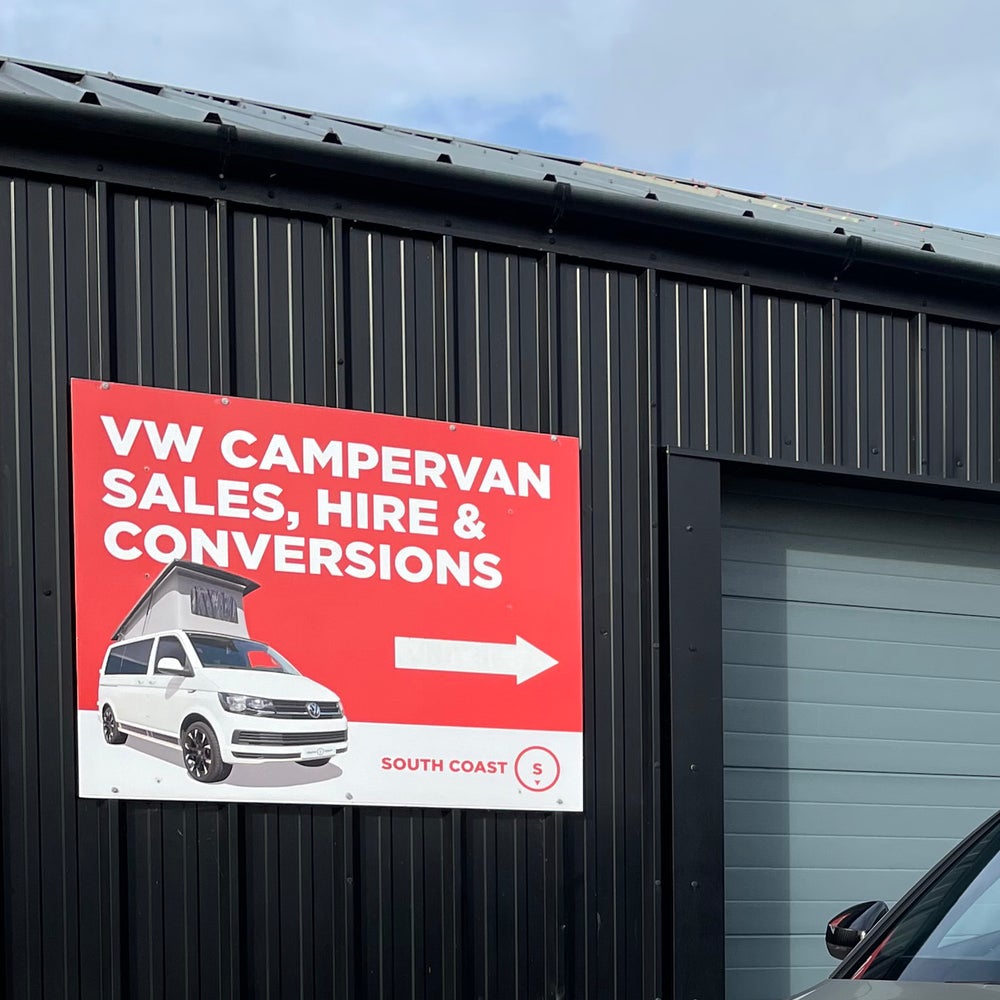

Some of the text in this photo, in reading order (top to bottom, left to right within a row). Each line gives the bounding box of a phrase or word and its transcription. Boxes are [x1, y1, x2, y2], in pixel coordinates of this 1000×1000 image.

[101, 415, 551, 500] VW CAMPERVAN
[101, 468, 487, 541] SALES, HIRE &
[103, 520, 503, 590] CONVERSIONS
[381, 757, 508, 774] SOUTH COAST
[532, 762, 543, 775] S
